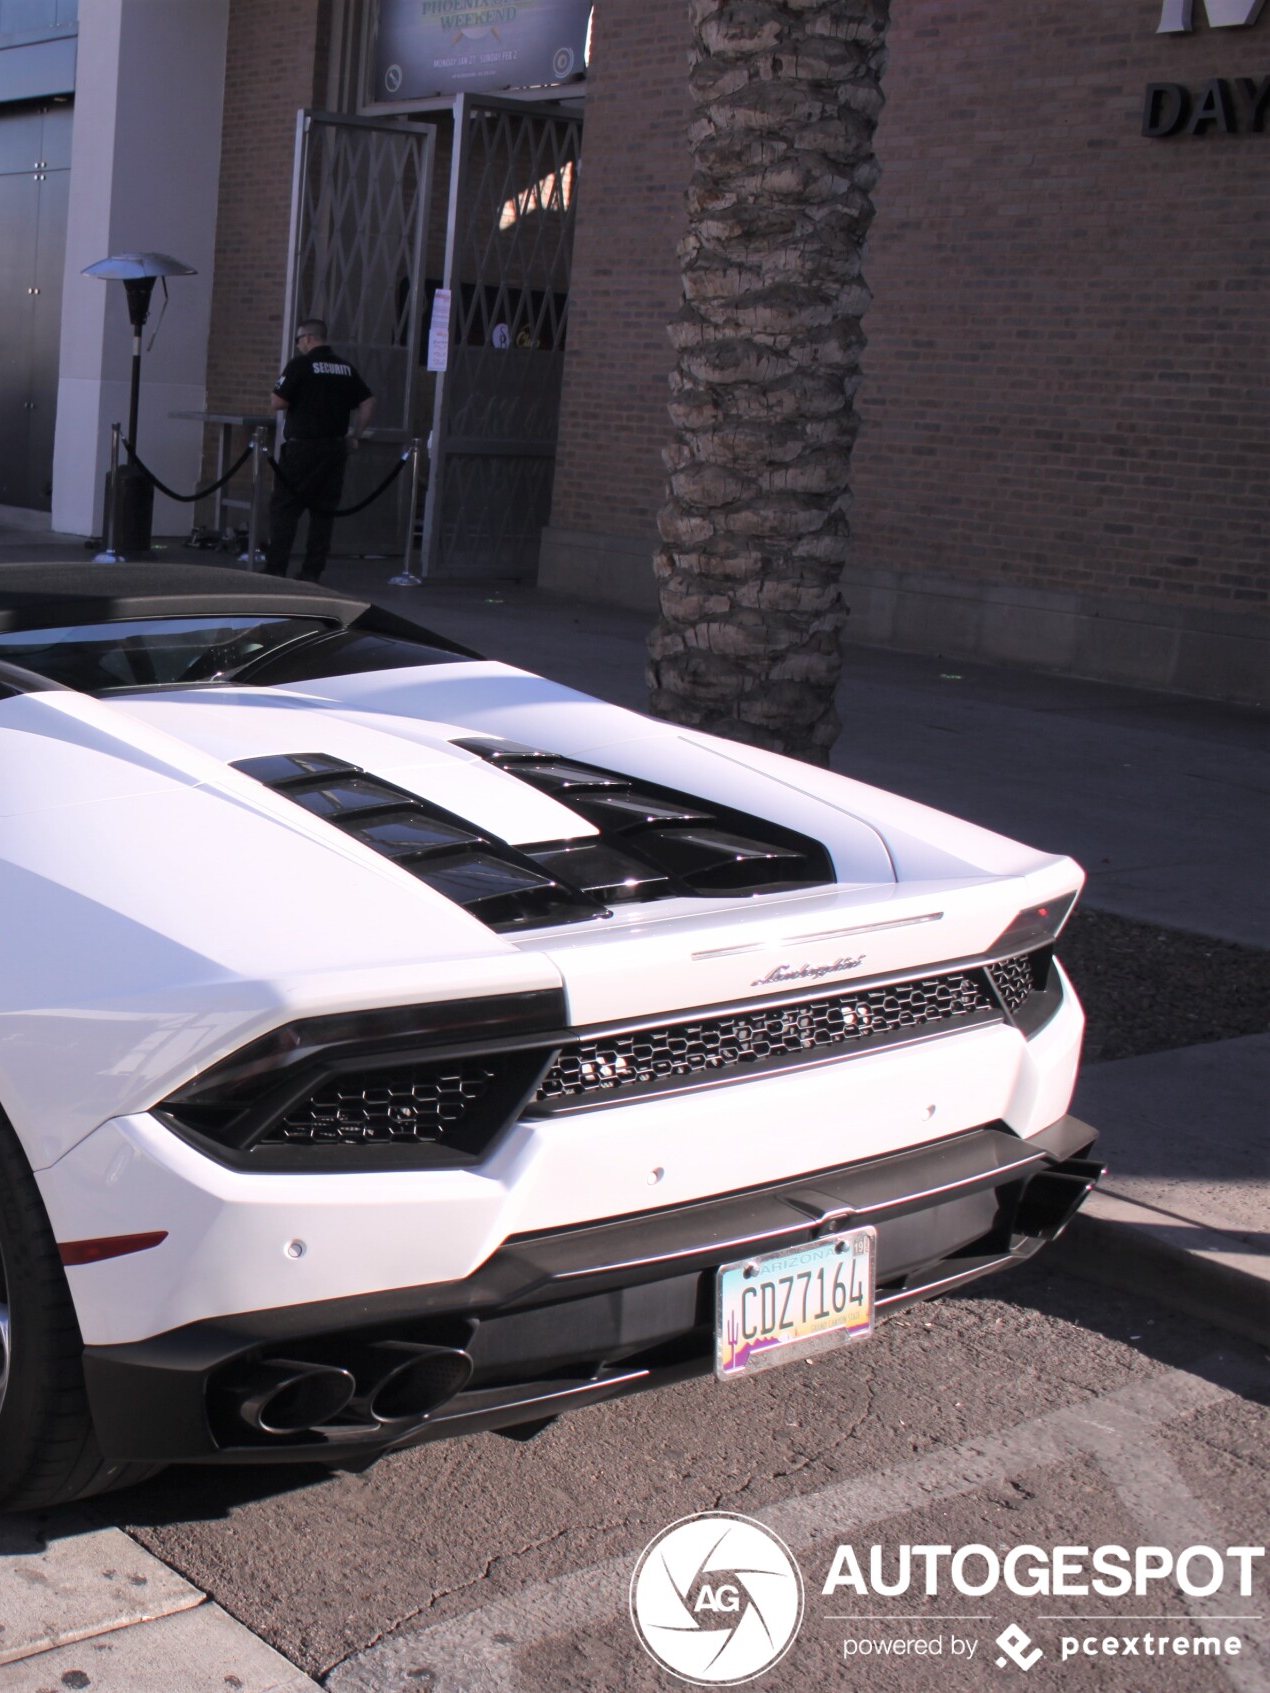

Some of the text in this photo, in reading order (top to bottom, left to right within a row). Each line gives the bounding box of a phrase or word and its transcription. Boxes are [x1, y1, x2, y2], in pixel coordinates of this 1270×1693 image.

[440, 7, 517, 29] WEEKEND
[433, 58, 457, 68] MONDAY
[457, 57, 469, 66] JAN
[480, 53, 502, 64] SUNDAY
[502, 52, 513, 61] FEB
[312, 362, 352, 376] SECURITY
[750, 954, 866, 987] Lamborghini
[854, 1242, 864, 1254] 19
[760, 1247, 836, 1275] ARIZONA
[741, 1258, 863, 1340] CDZ7164
